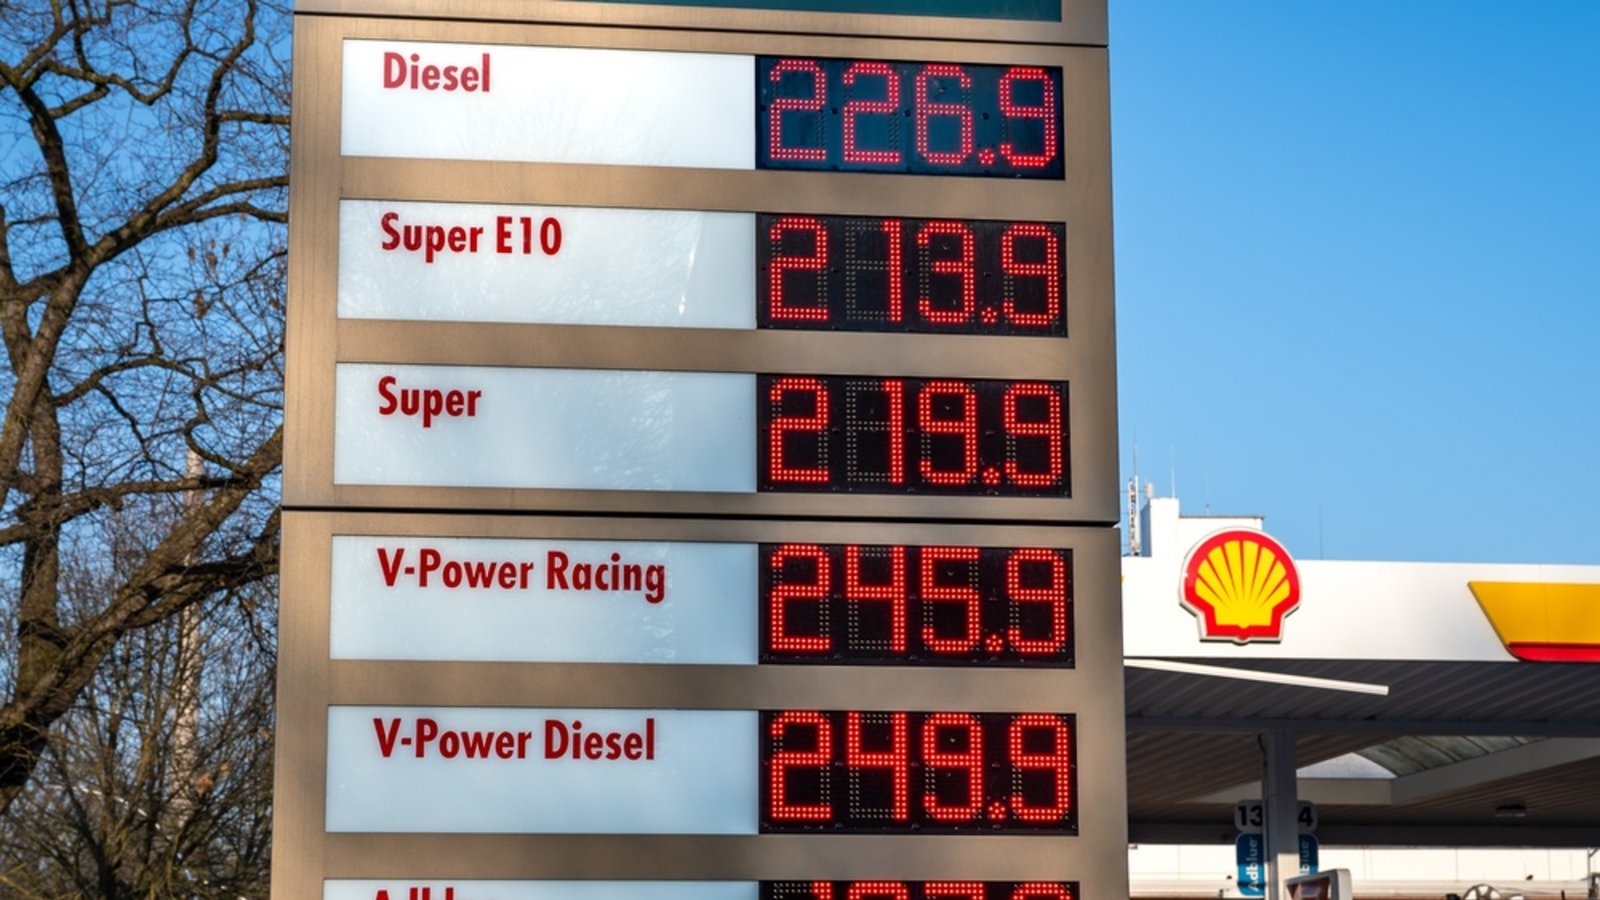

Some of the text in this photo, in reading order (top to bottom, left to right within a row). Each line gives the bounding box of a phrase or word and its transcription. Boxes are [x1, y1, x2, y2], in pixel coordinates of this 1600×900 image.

[383, 51, 491, 92] Diesel
[767, 59, 1058, 168] 226.9
[381, 212, 562, 264] Super E10
[769, 216, 1062, 327] 213.9
[378, 375, 481, 427] Super
[769, 377, 1064, 487] 219.9
[378, 548, 665, 603] V-Power Racing
[769, 543, 1068, 655] 245.9
[374, 718, 655, 760] V-Power Diesel
[770, 710, 1072, 822] 249.9
[1238, 805, 1262, 827] 13
